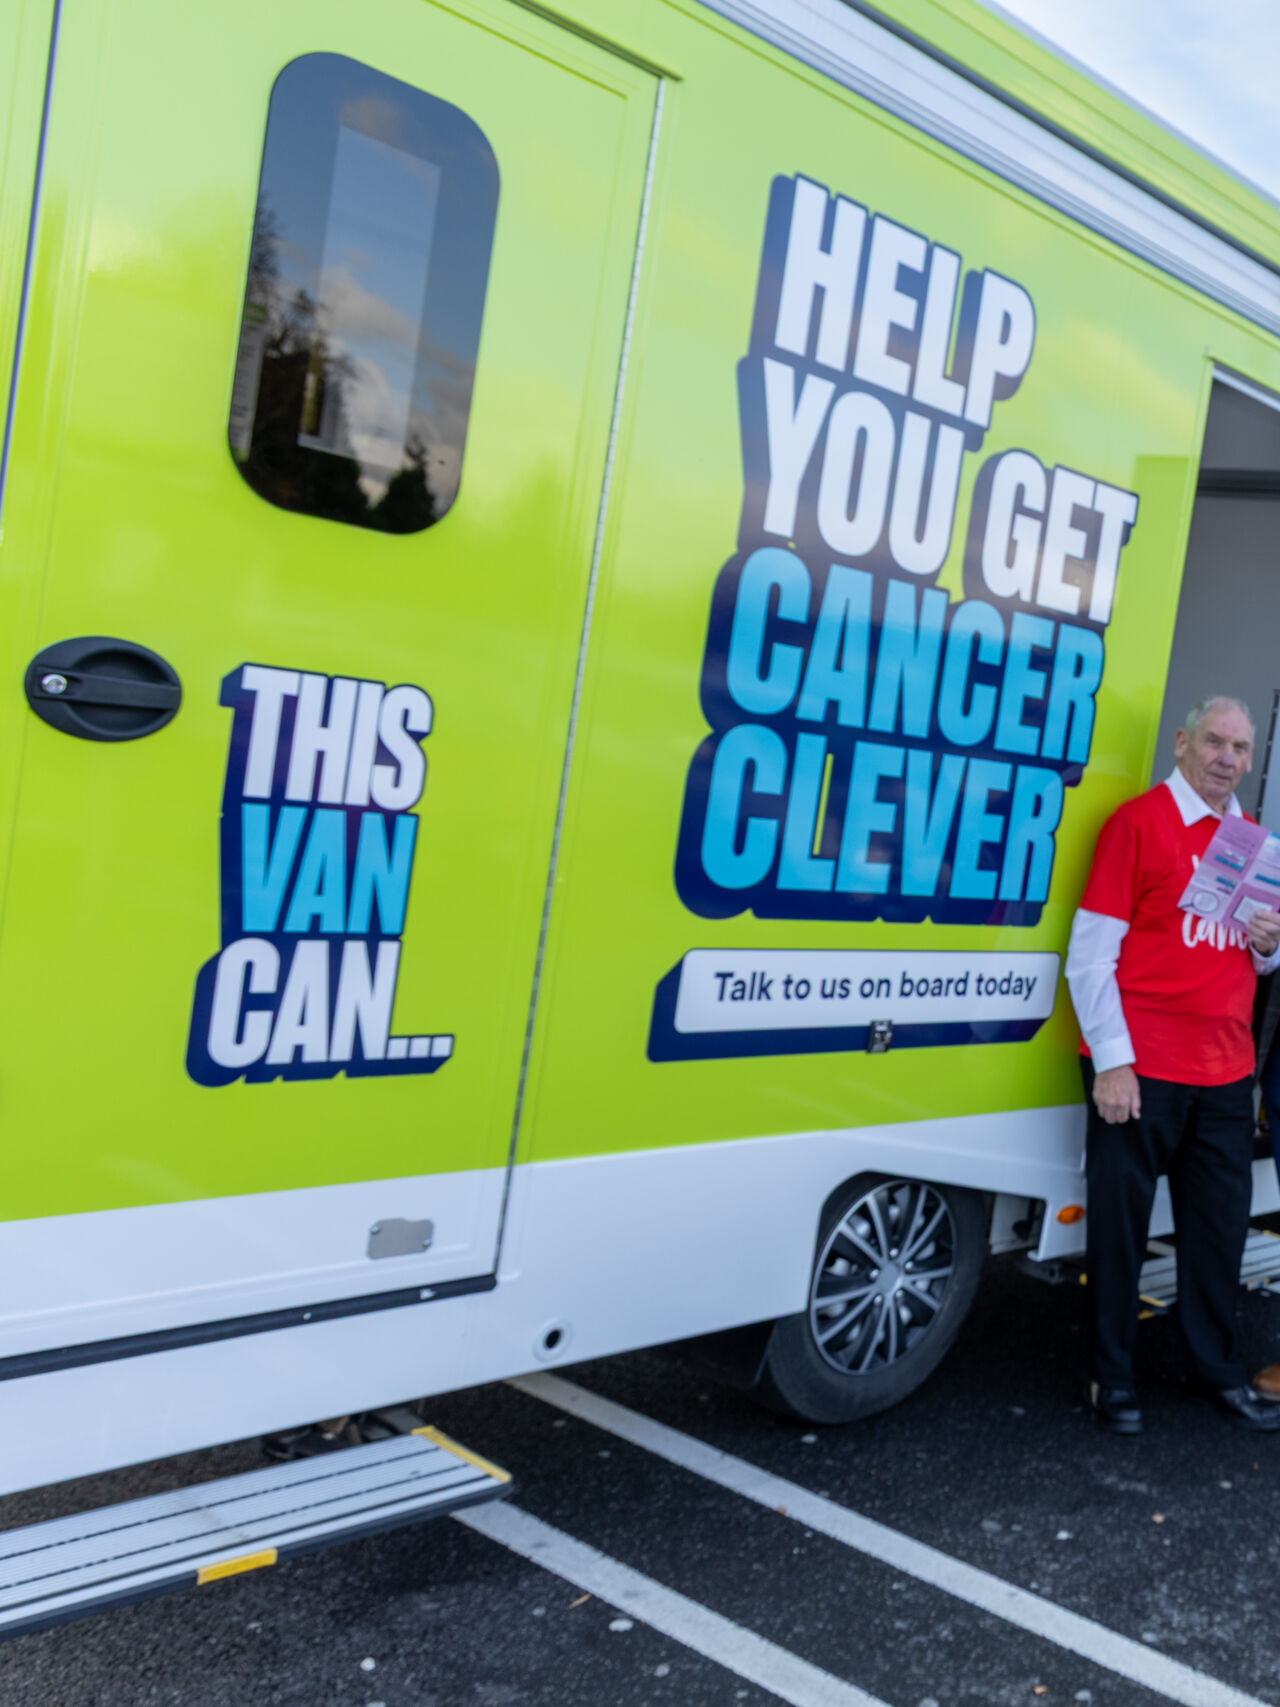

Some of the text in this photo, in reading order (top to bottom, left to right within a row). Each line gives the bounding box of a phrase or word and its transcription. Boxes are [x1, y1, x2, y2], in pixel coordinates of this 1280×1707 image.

[773, 173, 1036, 430] HELP
[762, 356, 1139, 625] YOU GET
[240, 663, 434, 811] THIS
[725, 546, 1105, 765] CANCER
[240, 802, 419, 934] VAN
[700, 722, 1065, 903] CLEVER
[207, 937, 455, 1069] CAN...
[715, 970, 1038, 1002] Talk to us on board today
